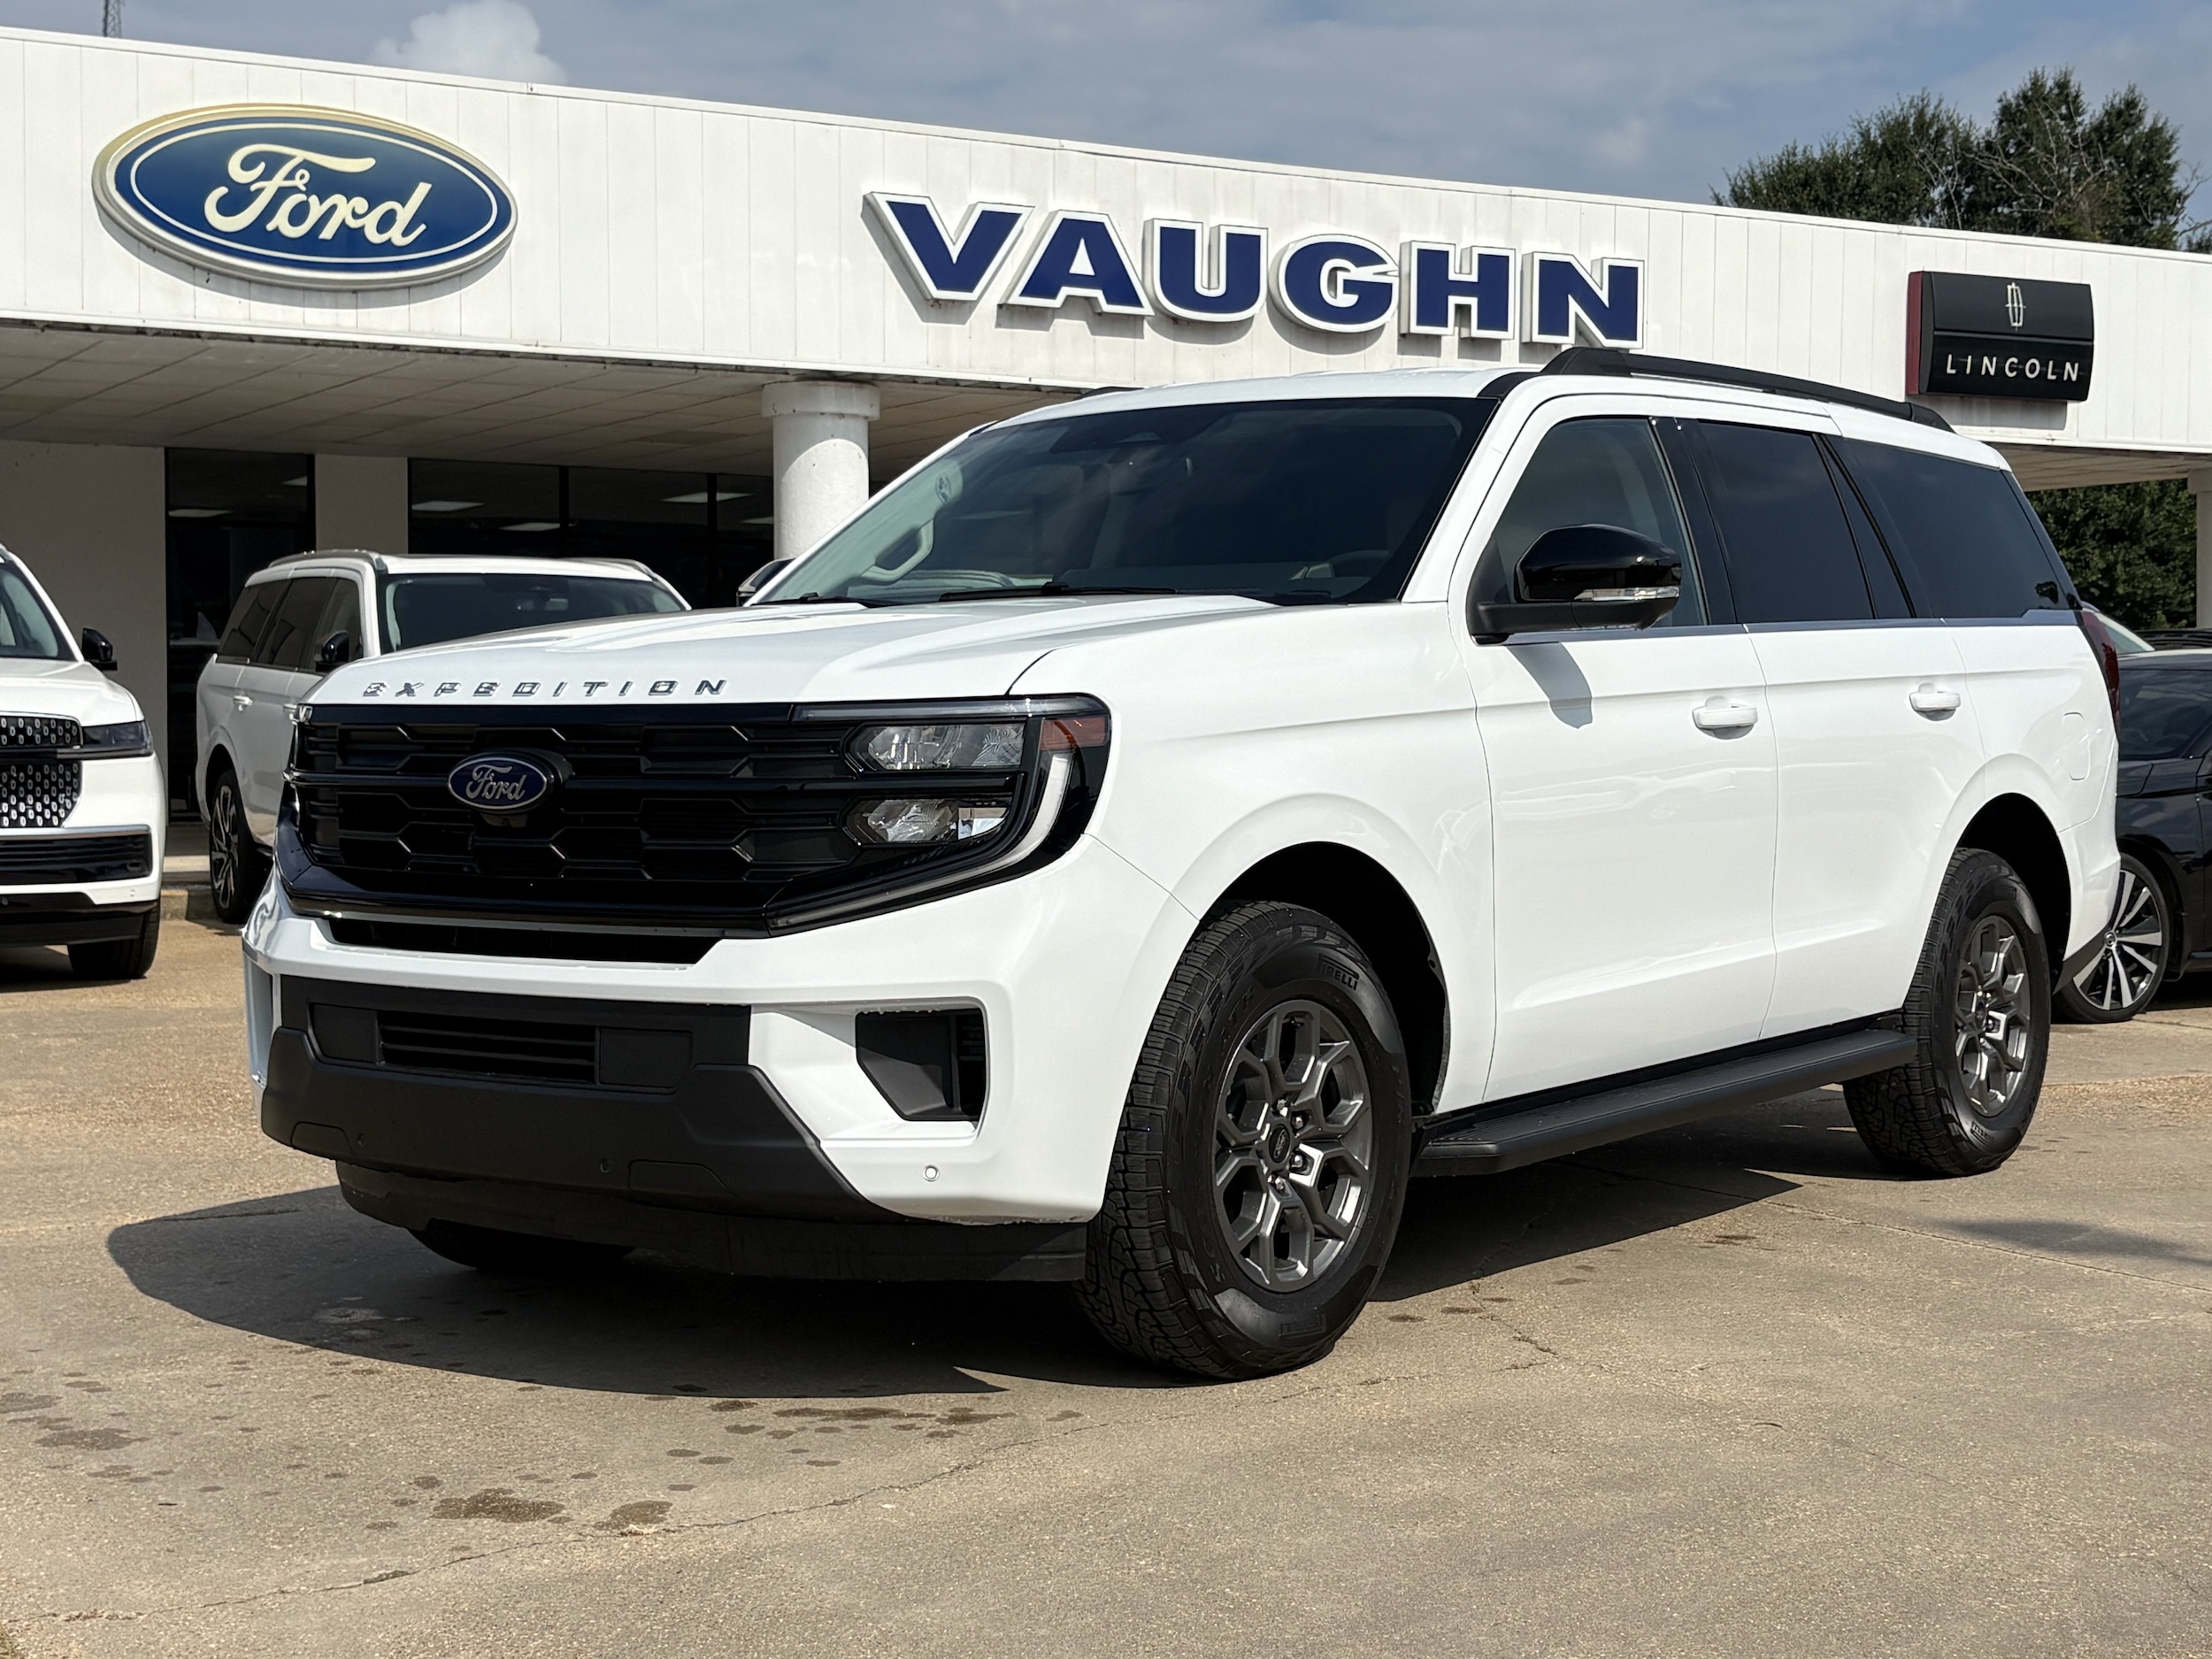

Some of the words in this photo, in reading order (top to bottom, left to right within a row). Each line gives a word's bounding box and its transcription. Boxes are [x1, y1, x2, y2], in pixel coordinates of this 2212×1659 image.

[204, 143, 432, 246] Ford
[865, 192, 1644, 348] VAUGHN
[1947, 354, 2079, 381] LINCOLN
[363, 680, 727, 697] EXPEDITION
[465, 764, 526, 800] Ford
